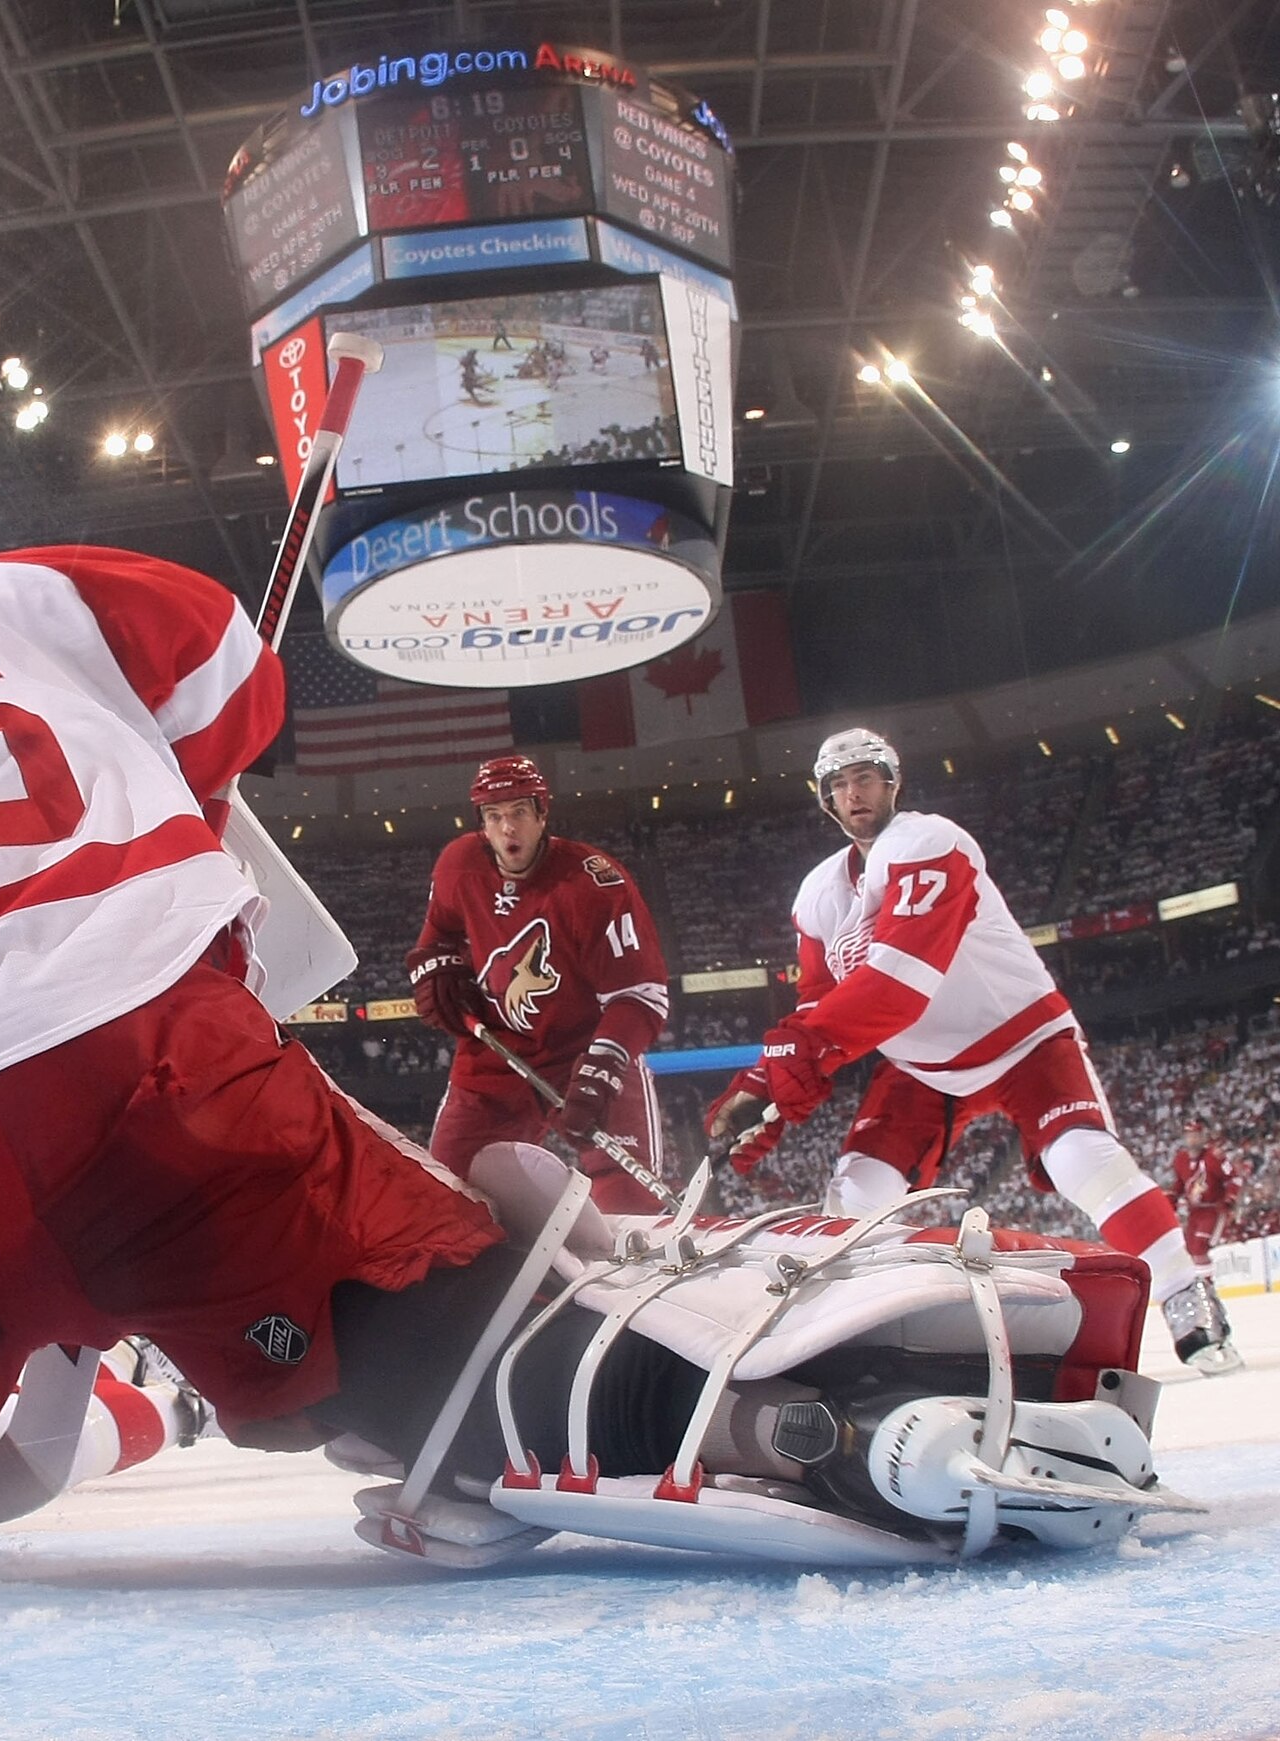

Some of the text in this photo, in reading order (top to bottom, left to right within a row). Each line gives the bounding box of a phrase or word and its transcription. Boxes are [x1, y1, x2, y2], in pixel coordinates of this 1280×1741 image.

[300, 48, 528, 118] Jobing.com
[617, 102, 650, 129] RED
[651, 116, 708, 160] WINGS
[635, 137, 715, 188] COYOTES
[612, 173, 649, 202] WED
[480, 232, 579, 254] Checking
[288, 366, 313, 471] TOYO
[350, 491, 619, 582] Desert Schools
[344, 607, 706, 651] Jobing.com
[421, 596, 626, 628] ARENA
[892, 869, 948, 916] 17
[605, 912, 640, 958] 14
[272, 1326, 288, 1358] NHL
